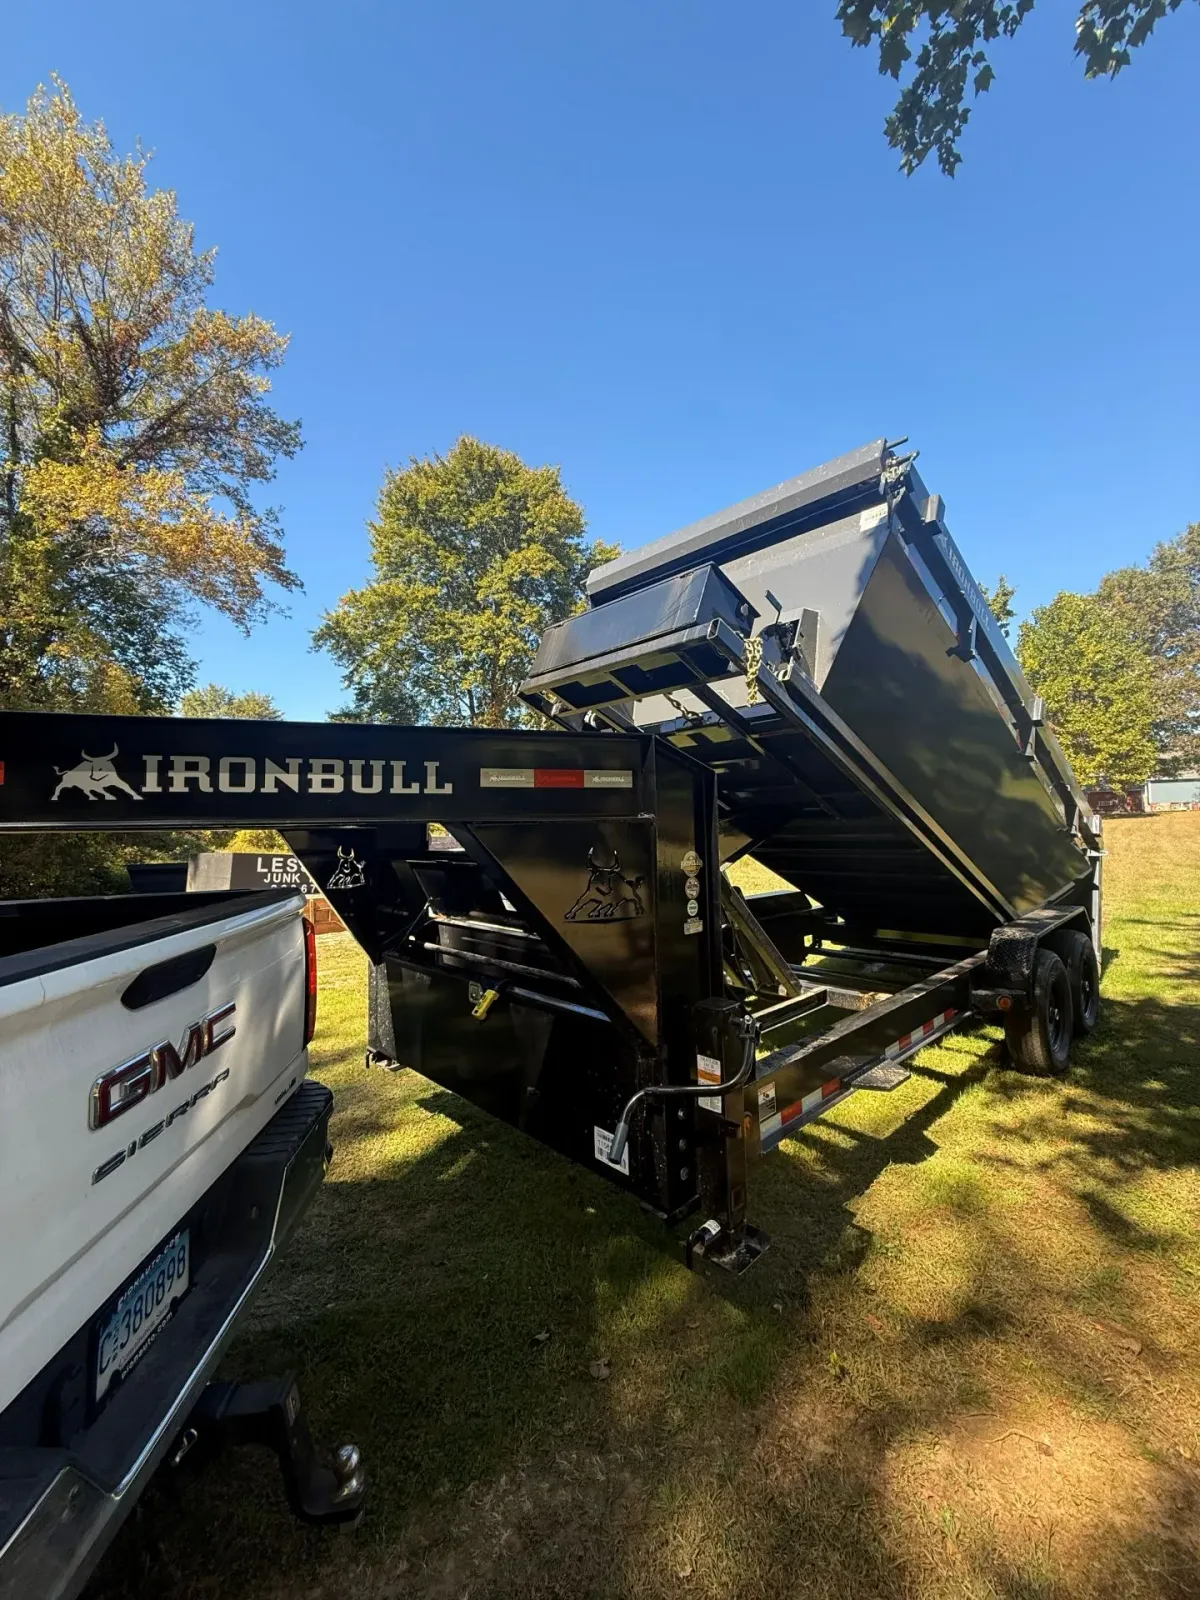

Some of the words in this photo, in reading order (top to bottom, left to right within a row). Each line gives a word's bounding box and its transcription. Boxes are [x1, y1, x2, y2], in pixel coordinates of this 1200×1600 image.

[141, 755, 453, 795] IRONBULL
[256, 857, 306, 873] LES
[263, 873, 301, 884] JUNK
[88, 1001, 236, 1132] GMC
[91, 1067, 230, 1186] SIERRA
